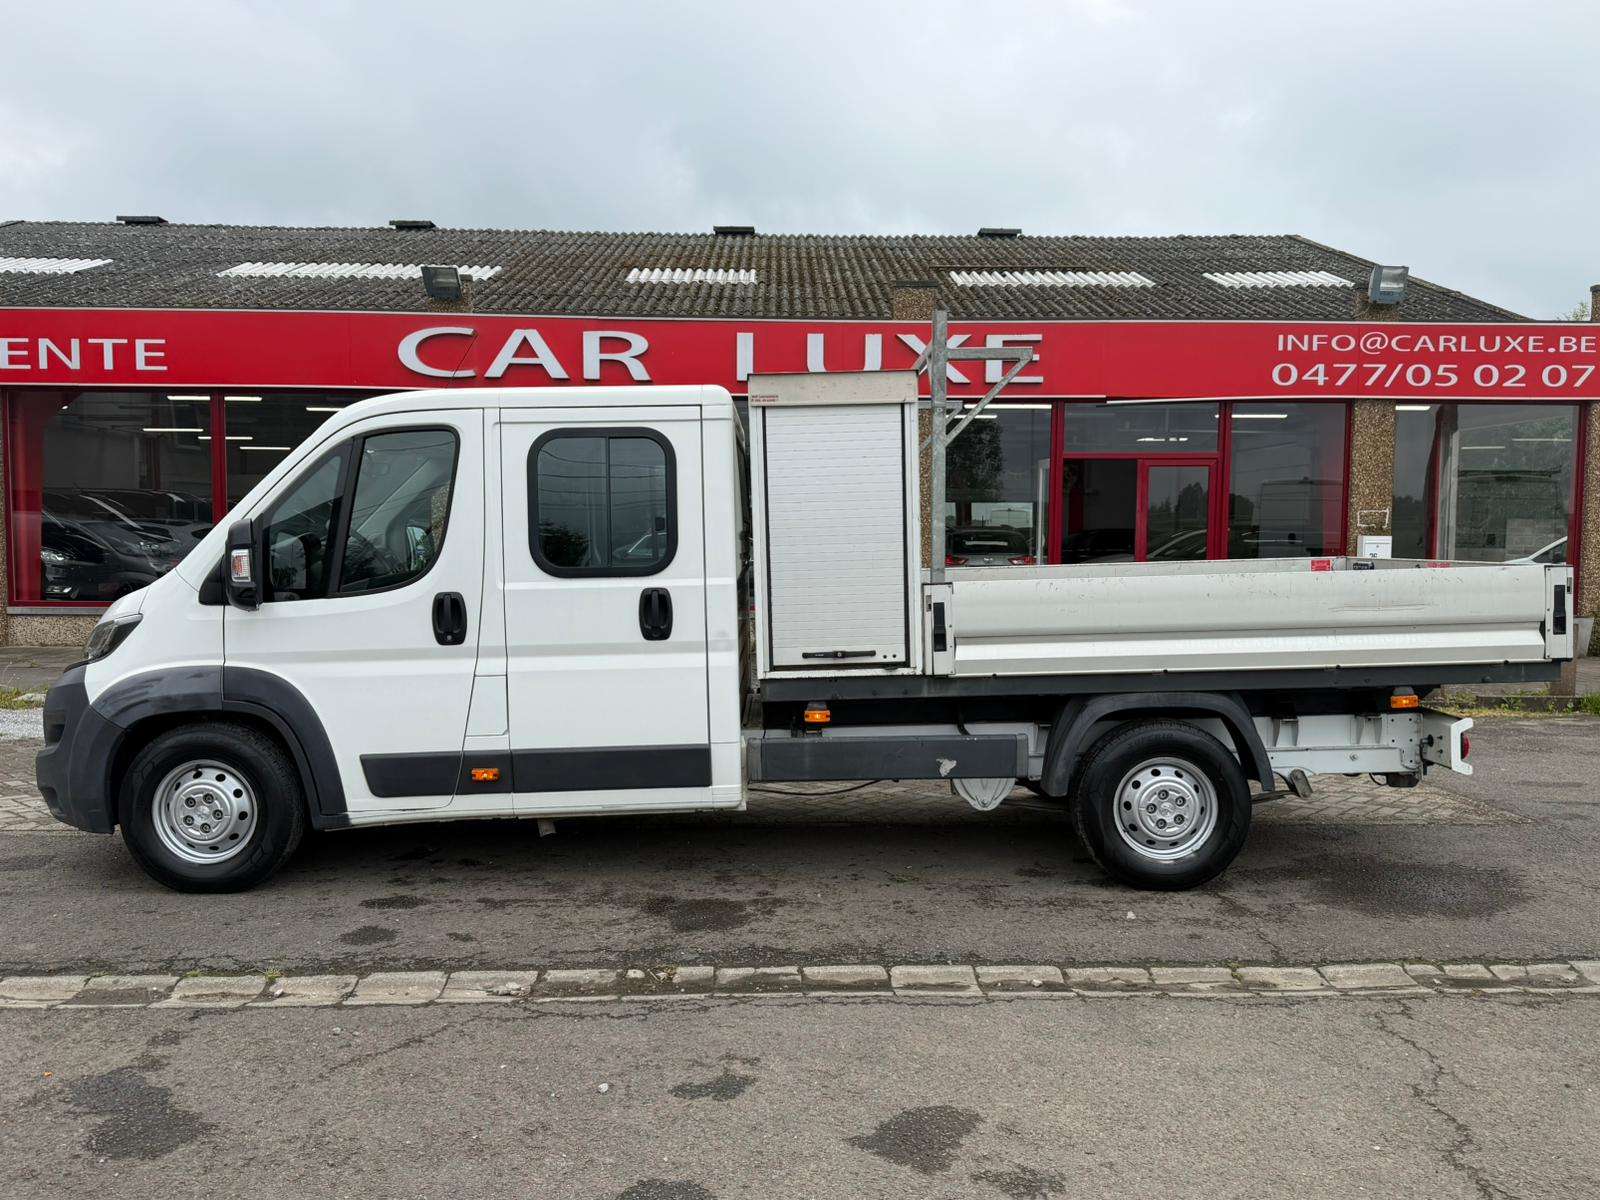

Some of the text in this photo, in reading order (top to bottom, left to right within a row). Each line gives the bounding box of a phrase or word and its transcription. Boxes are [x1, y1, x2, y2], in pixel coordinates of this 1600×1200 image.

[0, 337, 168, 371] ENTE
[397, 326, 652, 381] CAR
[1277, 331, 1597, 355] INFO@CARLUXE.BE
[1271, 363, 1596, 388] 0477/05 02 07
